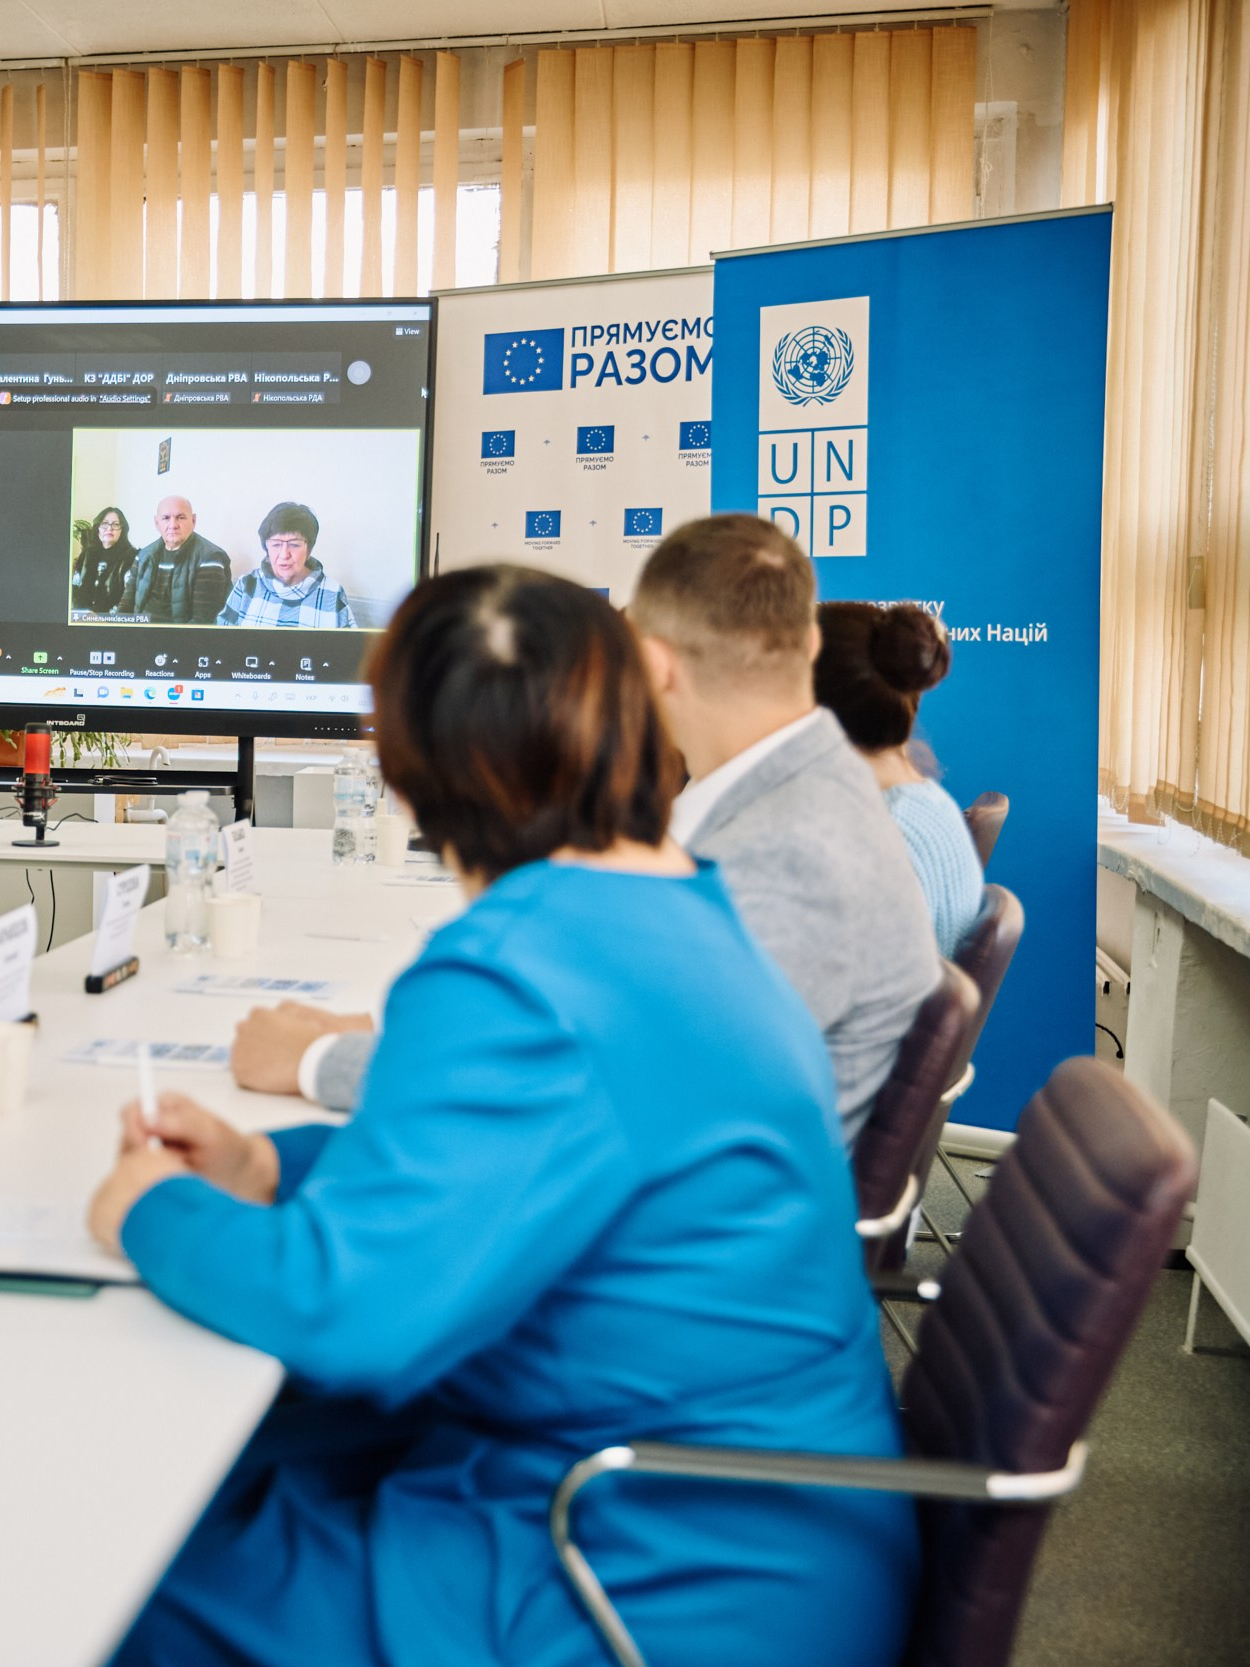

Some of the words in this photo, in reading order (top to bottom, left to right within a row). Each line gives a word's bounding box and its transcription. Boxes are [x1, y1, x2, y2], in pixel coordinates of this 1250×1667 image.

[404, 328, 420, 336] View
[570, 345, 713, 389] РАЗОМ
[43, 374, 73, 385] Гунь...
[84, 374, 96, 383] КЗ
[98, 373, 131, 385] "ДДБІ"
[132, 374, 154, 385] ДОР
[165, 373, 226, 385] Дніпровська
[228, 374, 248, 383] РВА
[254, 373, 320, 383] Нікопольська
[323, 374, 339, 383] Р...
[12, 394, 31, 404] Setup
[32, 394, 70, 404] professional
[71, 394, 89, 403] audio
[90, 394, 97, 403] in
[173, 394, 215, 403] Дніпровська
[215, 394, 229, 402] РВА
[263, 394, 307, 402] Нікопольська
[308, 394, 323, 403] РДА
[575, 455, 614, 464] ПРЯМУЄМО
[678, 451, 712, 461] ПРЯМУЄМ
[480, 460, 515, 468] ПРЯМУЄМО
[685, 459, 710, 468] РАЗОМ
[486, 467, 508, 475] РАЗОМ
[987, 622, 1048, 646] Націй
[38, 667, 60, 675] Screen
[69, 669, 104, 677] Pause/Stop
[104, 669, 135, 678] Recording
[145, 670, 175, 678] Reactions
[194, 671, 212, 679] Apps
[231, 672, 271, 680] Whiteboards
[295, 673, 315, 681] Notes
